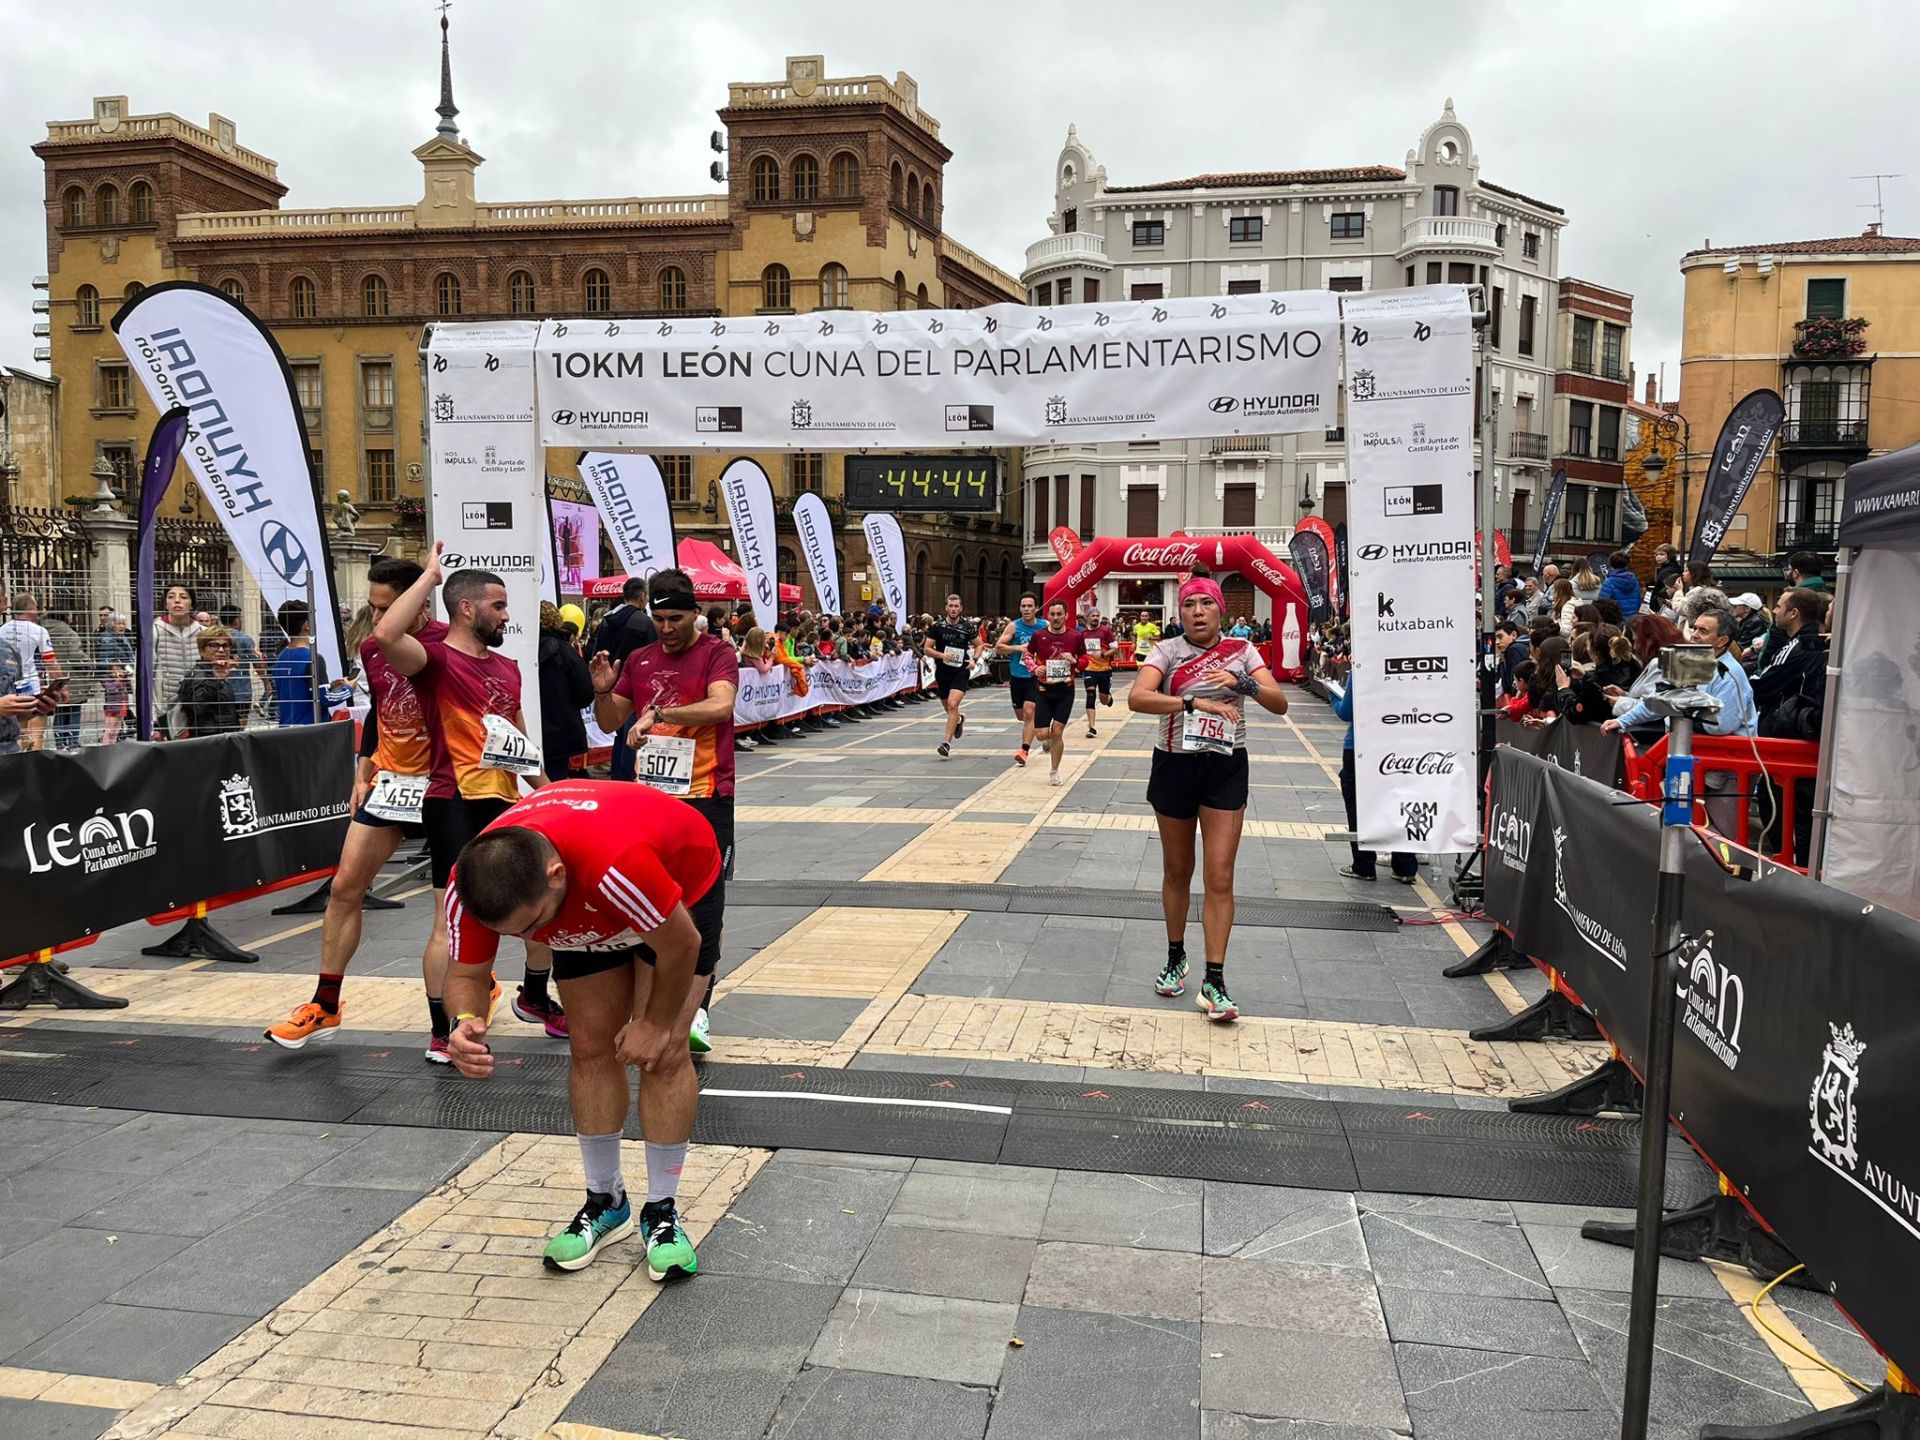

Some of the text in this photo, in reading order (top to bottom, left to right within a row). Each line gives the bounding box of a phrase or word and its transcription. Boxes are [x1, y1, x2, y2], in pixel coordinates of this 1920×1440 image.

[552, 331, 1322, 378] 10KM LEÓN CUNA DEL PARLAMENTARISMO
[1378, 388, 1438, 398] AYUNTAMIENTO
[1451, 385, 1471, 393] LEÓN
[1243, 394, 1319, 410] HYUNDAI
[517, 411, 533, 420] LEÓN
[580, 411, 648, 424] HYUNDAI
[948, 413, 968, 422] LEÓN
[1069, 414, 1123, 423] AYUNTAMIENTO
[1136, 411, 1156, 420] LEÓN
[1276, 406, 1319, 415] Automoción
[699, 415, 718, 424] LEÓN
[878, 419, 896, 428] LEÓN
[1428, 435, 1459, 445] Junta de
[1408, 445, 1434, 453] Castilla
[1441, 443, 1460, 451] León
[1721, 424, 1751, 472] León
[1721, 462, 1755, 525] AYUNTAMIENTO
[1751, 449, 1762, 464] DE
[1387, 495, 1412, 506] LEÓN
[465, 510, 485, 520] LEÓN
[1393, 541, 1472, 558] HYUNDAI
[470, 555, 535, 567] HYUNDAI
[1392, 554, 1472, 564] Lemauto Automoción
[1377, 616, 1454, 632] kutxabank
[1386, 658, 1447, 672] LEON
[1384, 673, 1449, 681] PLAZA
[1381, 707, 1454, 725] emico
[1198, 717, 1224, 740] 754
[646, 754, 678, 777] 507
[385, 787, 424, 807] 455
[320, 804, 331, 817] DE
[23, 807, 158, 874] León
[81, 838, 121, 865] Cuna del
[84, 844, 158, 875] Parlamentarismo
[1600, 928, 1612, 948] DE
[1688, 984, 1716, 1025] Cuna del
[1682, 1003, 1739, 1071] Parlamentarismo
